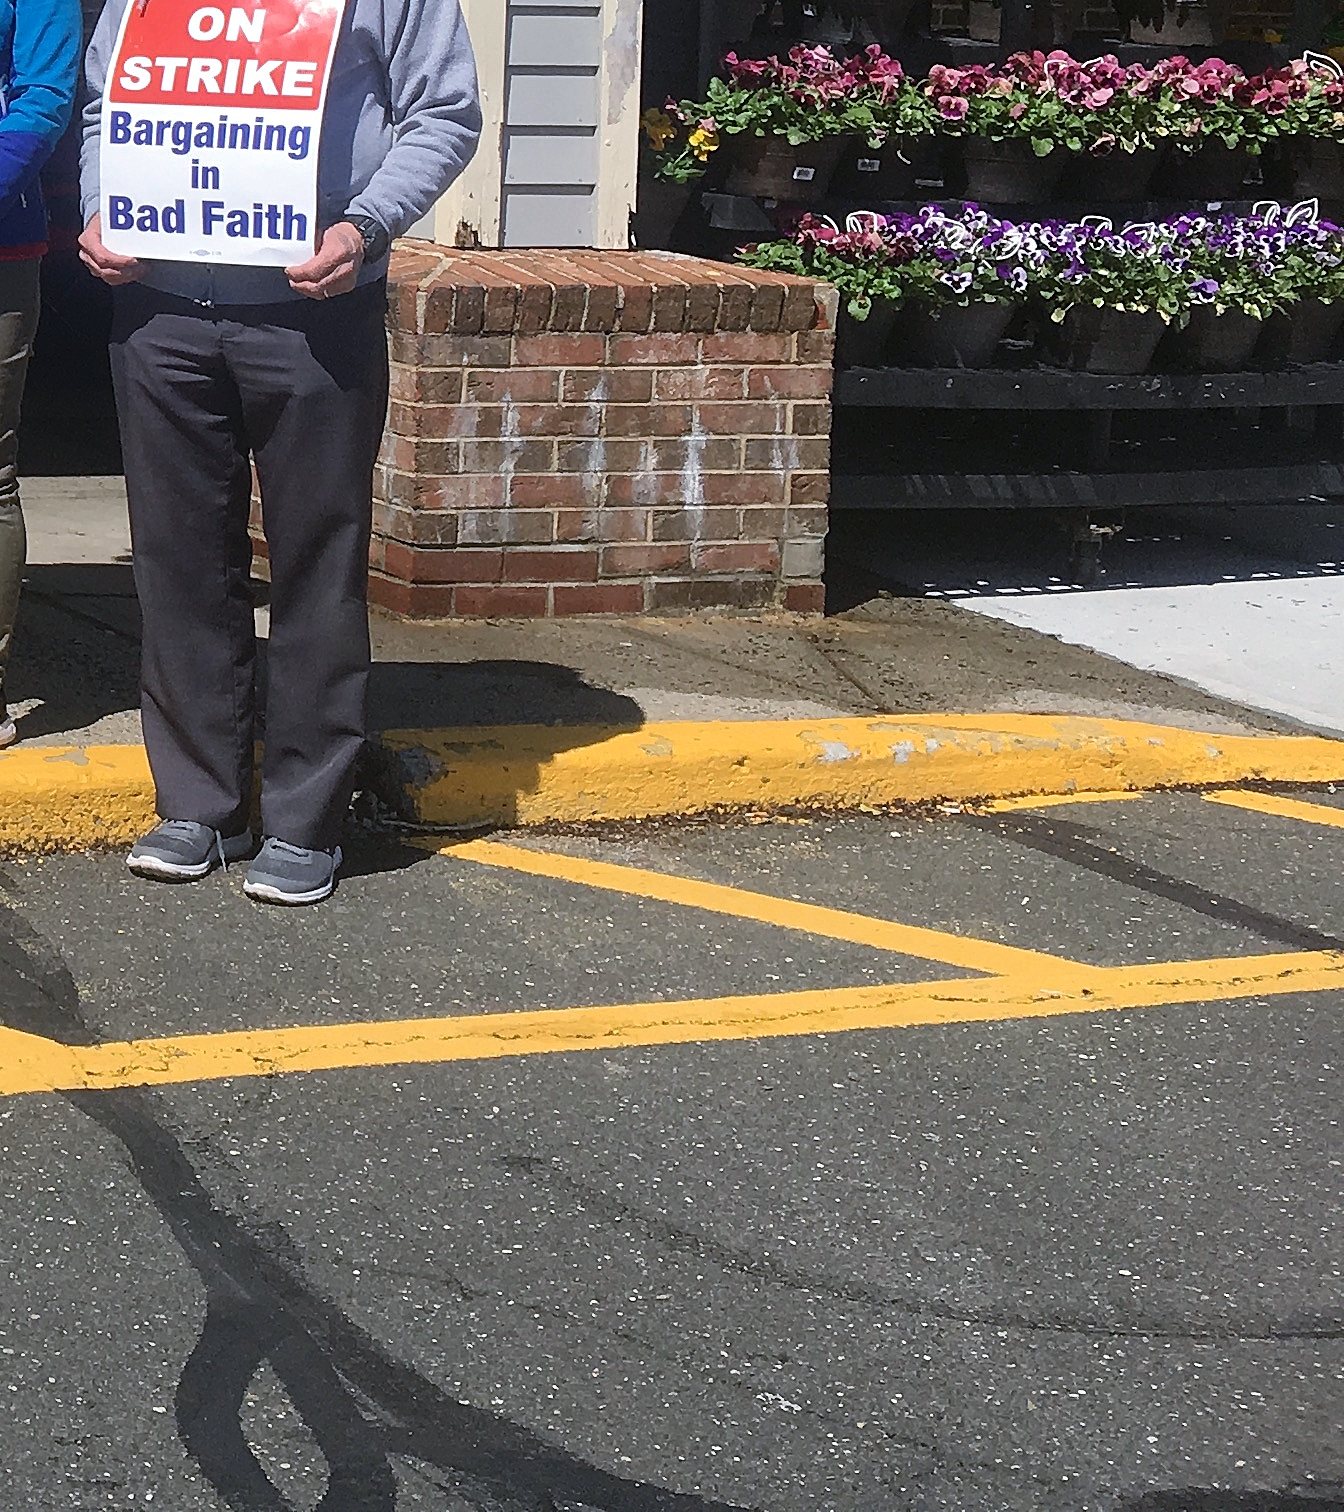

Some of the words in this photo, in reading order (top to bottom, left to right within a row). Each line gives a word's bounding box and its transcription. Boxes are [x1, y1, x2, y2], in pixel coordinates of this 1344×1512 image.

[187, 7, 267, 43] ON
[119, 56, 318, 97] STRIKE
[109, 110, 311, 160] Bargaining
[191, 159, 220, 190] in
[109, 195, 186, 235] Bad
[202, 200, 307, 241] Faith
